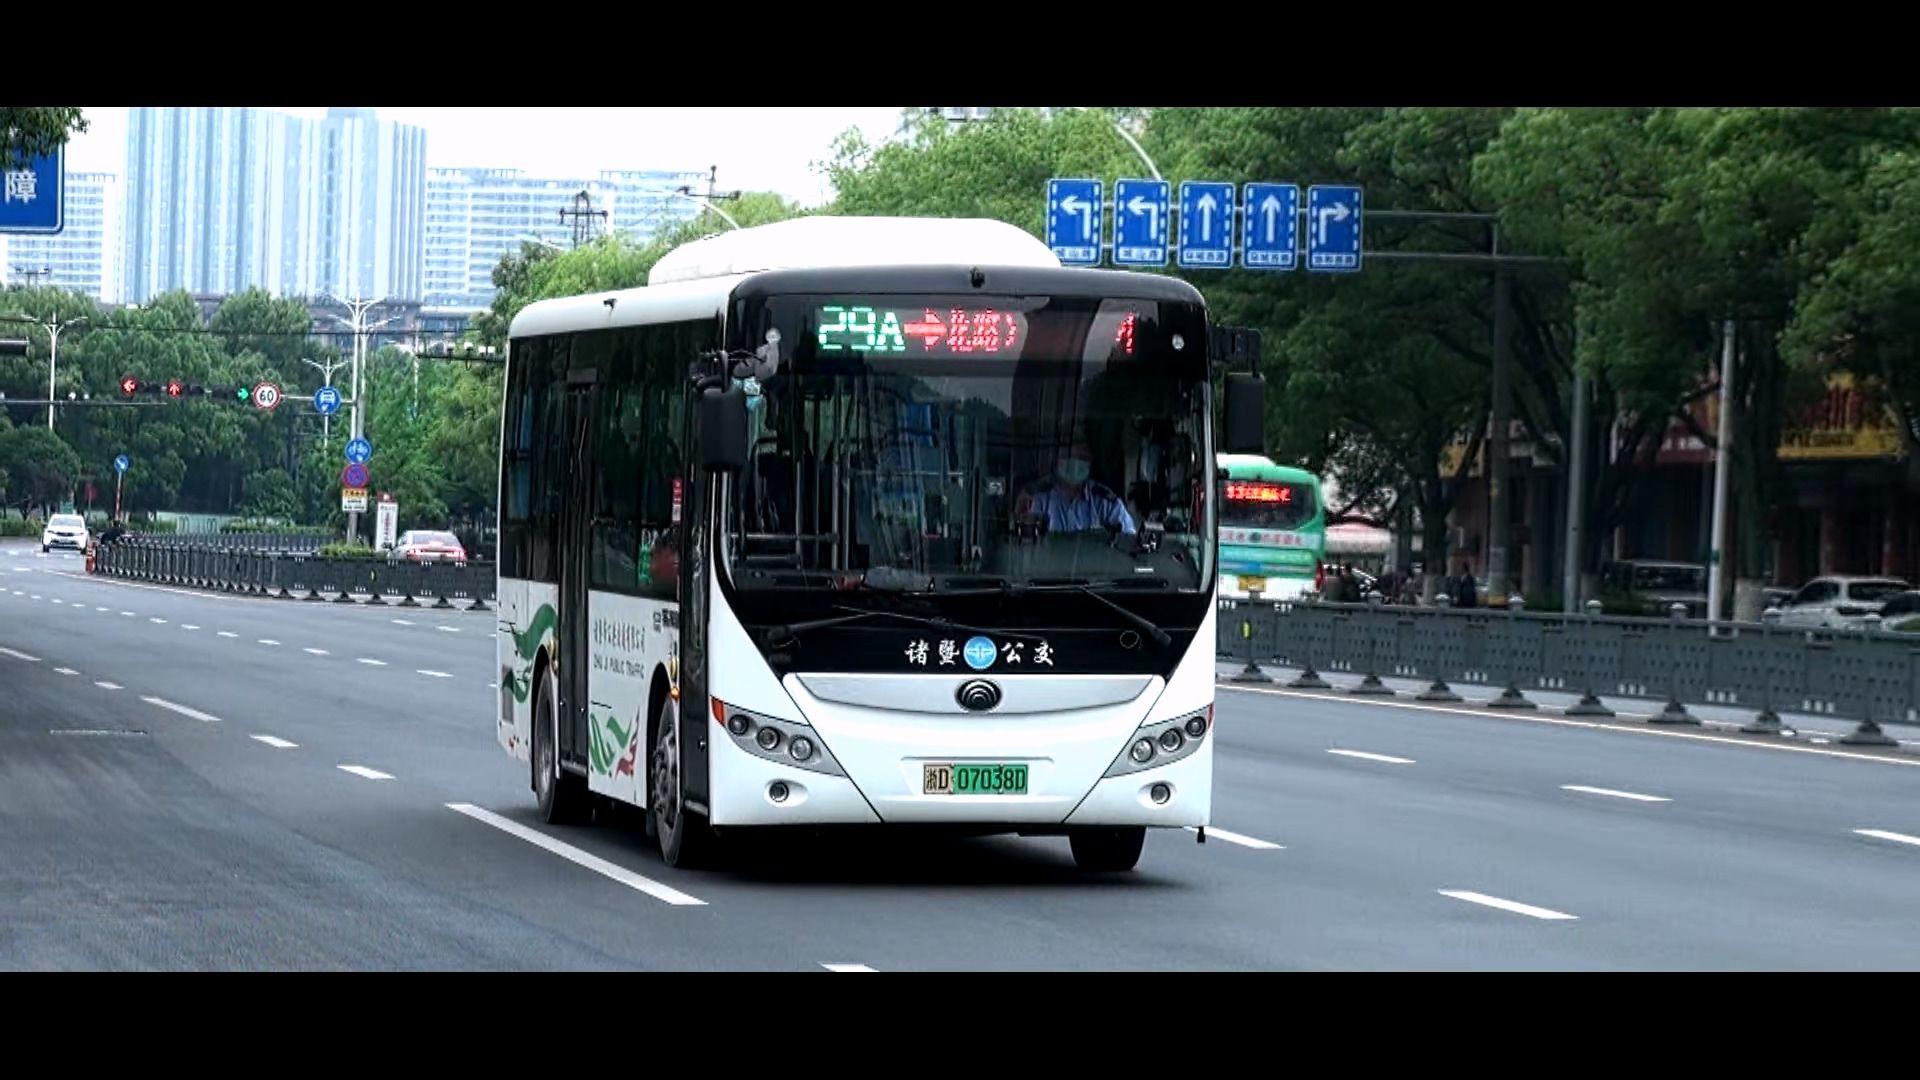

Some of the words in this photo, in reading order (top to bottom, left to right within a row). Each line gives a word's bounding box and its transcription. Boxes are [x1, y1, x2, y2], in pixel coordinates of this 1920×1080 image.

[5, 170, 37, 204] 障
[819, 306, 906, 351] 29A
[260, 390, 274, 402] 60
[905, 639, 960, 666] 诸暨
[1000, 641, 1054, 666] 公交
